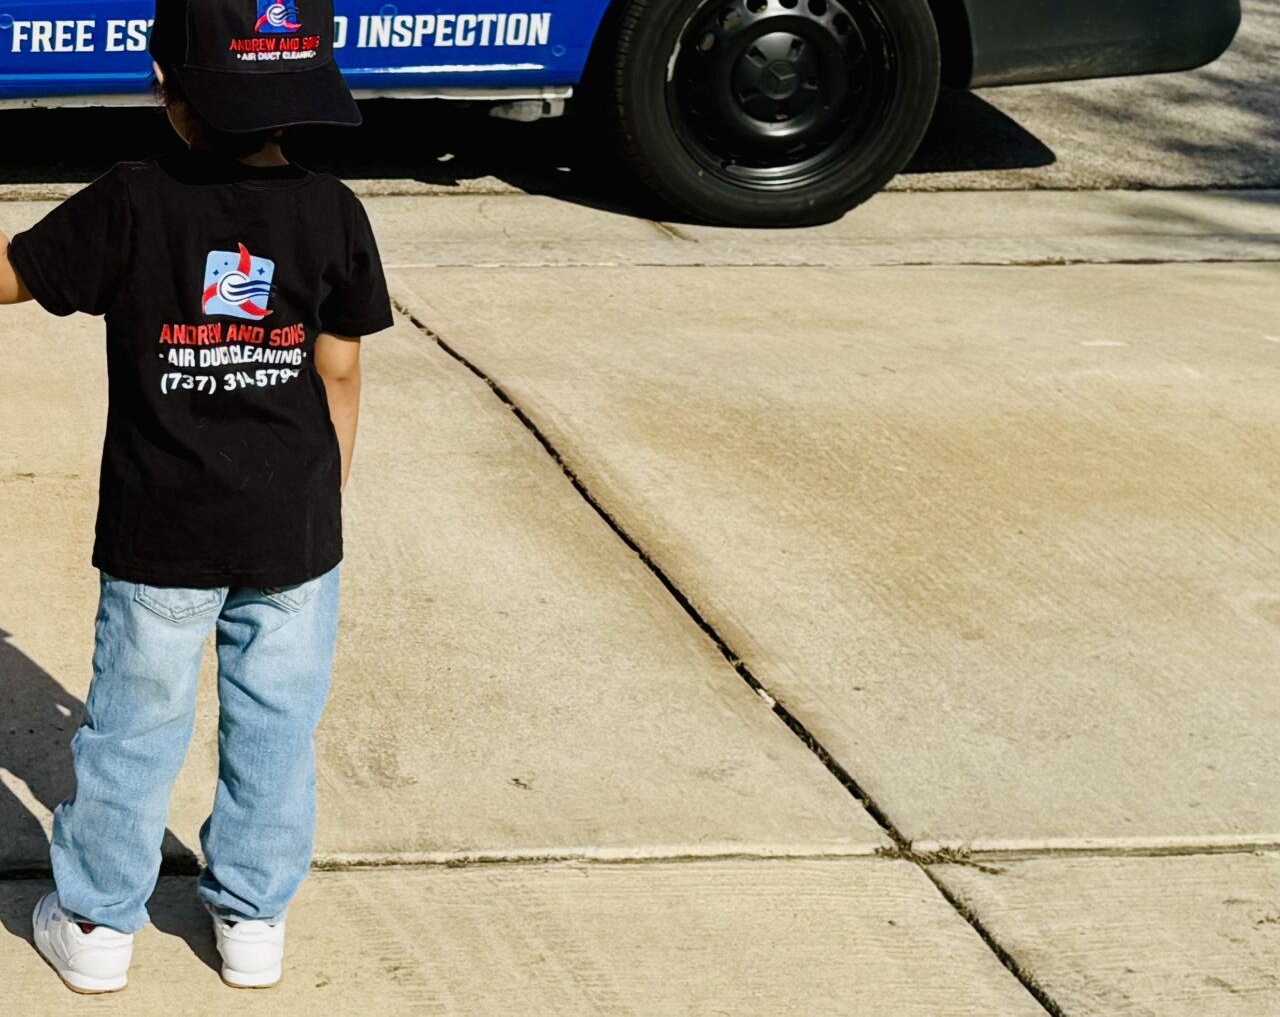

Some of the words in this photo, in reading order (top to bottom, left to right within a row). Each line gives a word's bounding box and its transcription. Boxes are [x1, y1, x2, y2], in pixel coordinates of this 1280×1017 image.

[11, 20, 95, 52] FREE
[357, 13, 551, 48] INSPECTION
[229, 38, 276, 51] ANDREW
[280, 37, 299, 51] AND
[241, 52, 256, 61] AIR
[258, 51, 281, 60] DUCT
[158, 322, 222, 345] ANDREW
[225, 323, 265, 344] AND
[269, 322, 306, 347] SONS
[167, 347, 196, 368] AIR
[160, 372, 217, 395] (737)
